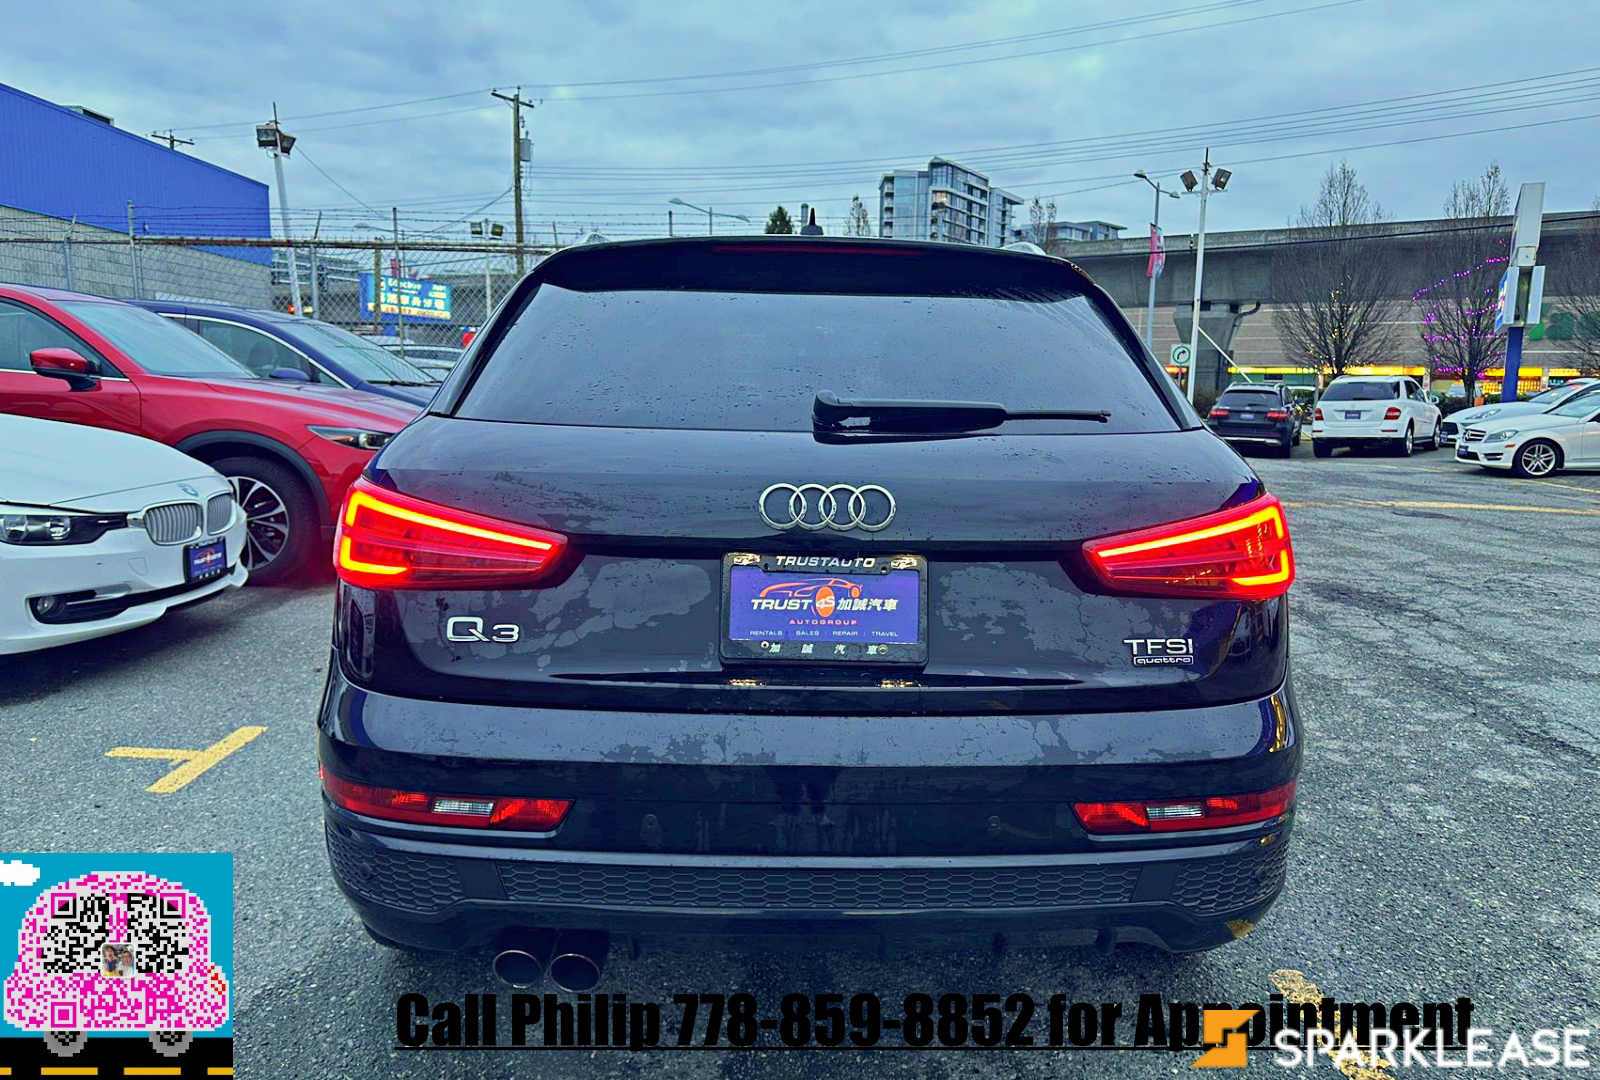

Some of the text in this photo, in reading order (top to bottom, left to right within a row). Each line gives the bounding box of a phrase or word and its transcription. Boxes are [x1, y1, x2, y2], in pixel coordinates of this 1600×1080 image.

[776, 555, 876, 568] TRUSTAUTO
[751, 599, 813, 610] TRUST
[446, 616, 520, 642] Q3
[1123, 638, 1194, 655] TFSI
[1136, 656, 1191, 665] quattro
